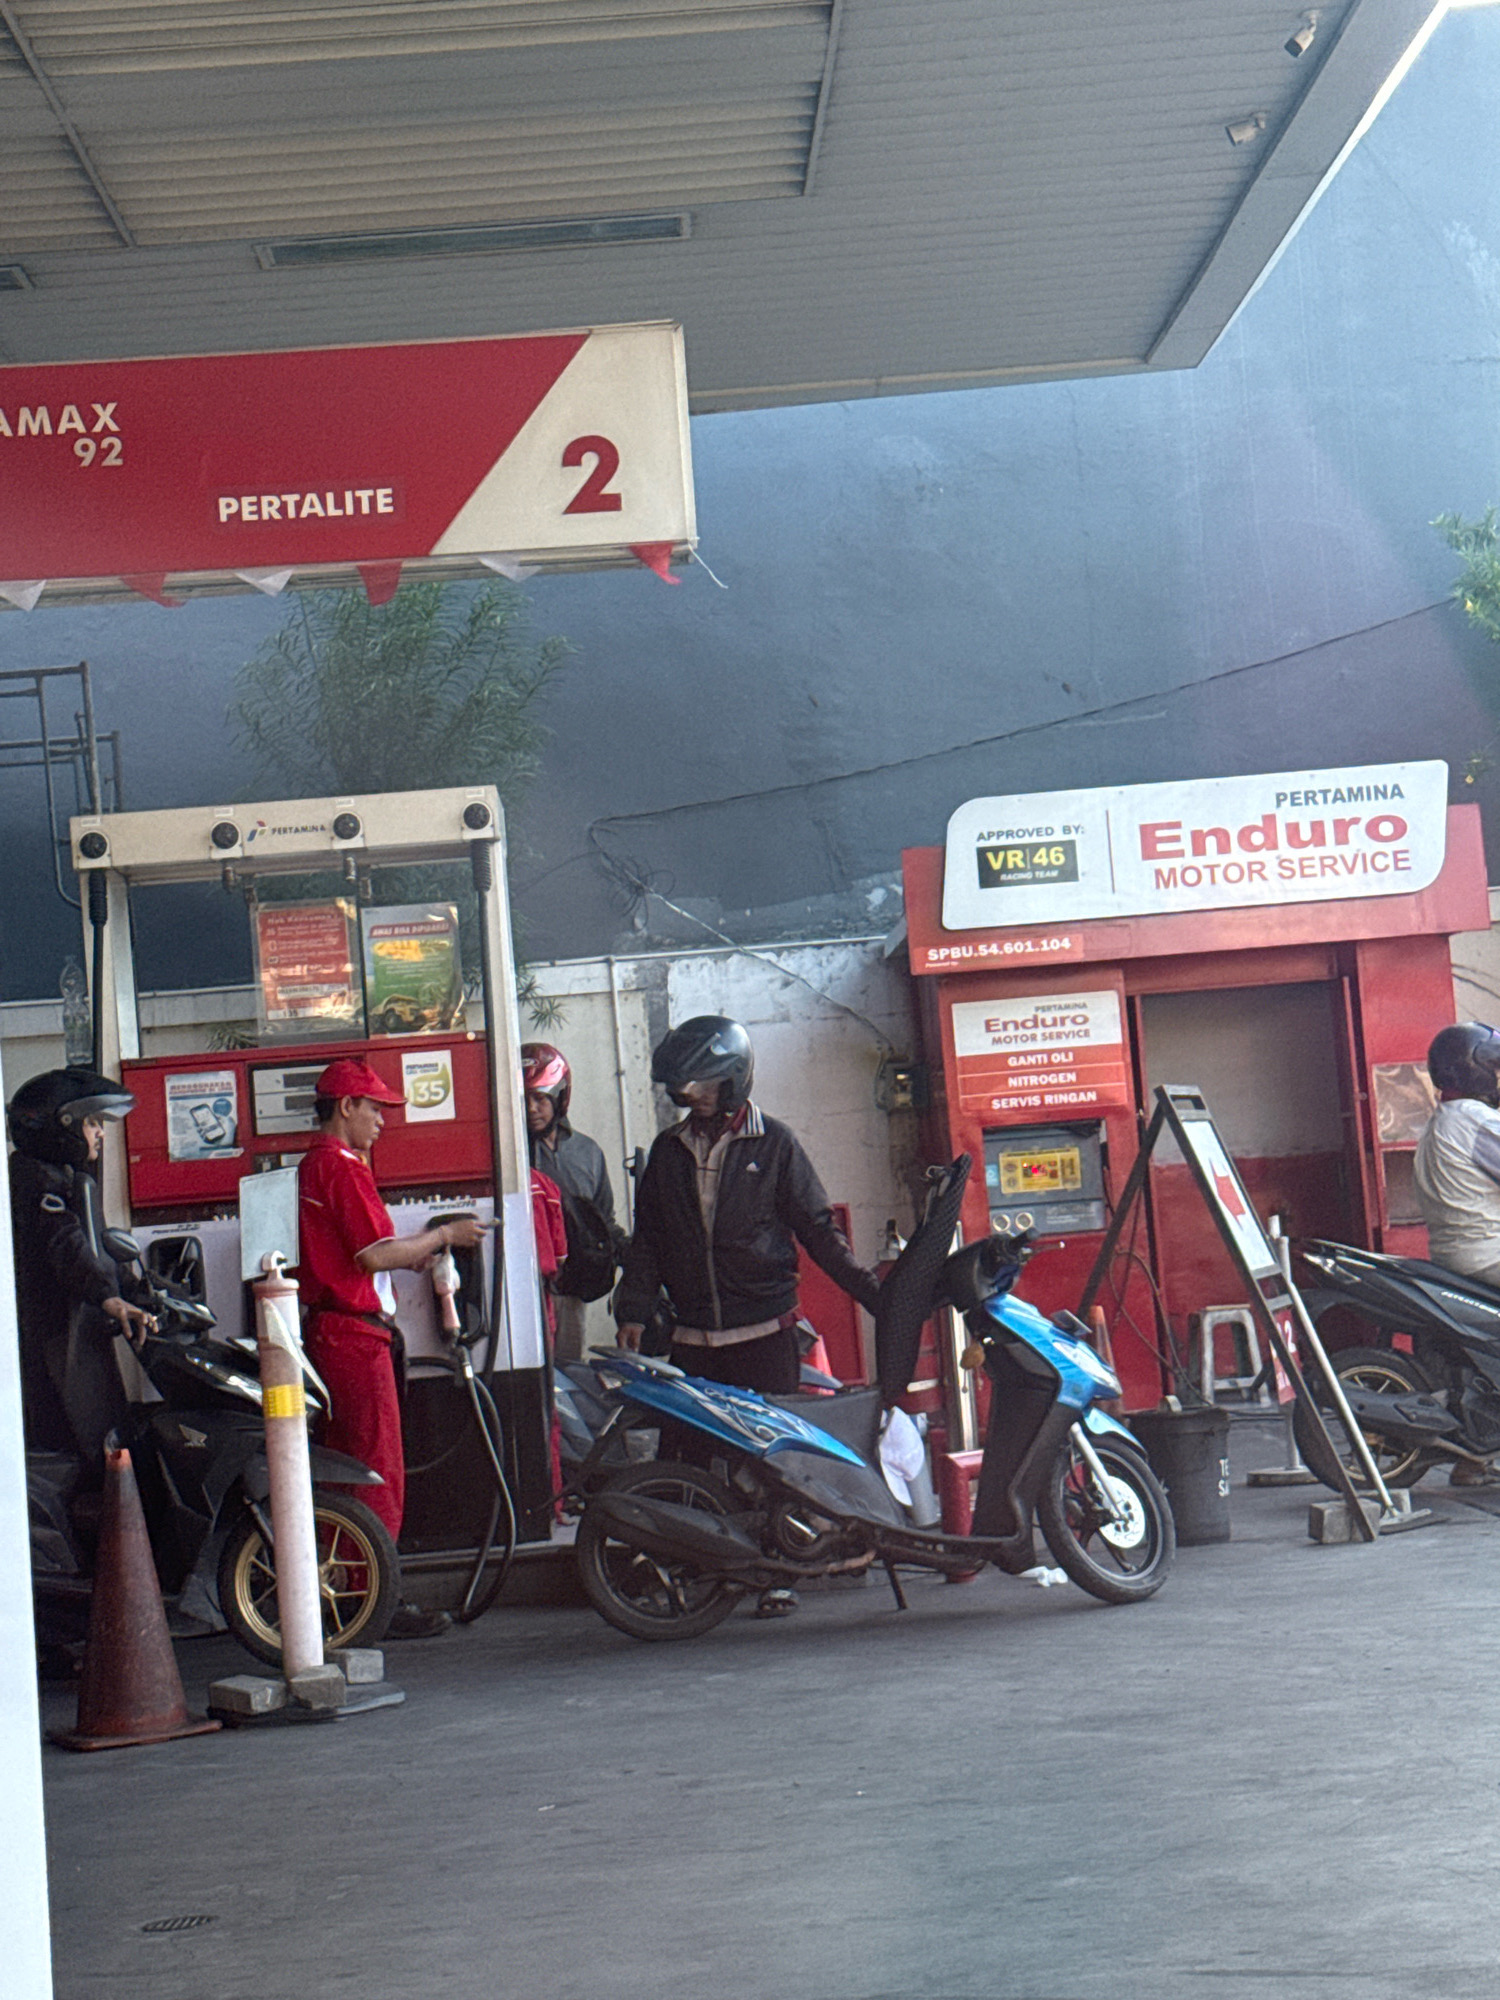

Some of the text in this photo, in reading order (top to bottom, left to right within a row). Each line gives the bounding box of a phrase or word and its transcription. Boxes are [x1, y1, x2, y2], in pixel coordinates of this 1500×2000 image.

[73, 436, 124, 468] 92
[561, 434, 623, 515] 2
[218, 487, 395, 523] PERTALITE
[1275, 783, 1405, 809] PERTAMINA
[271, 824, 326, 836] PERTAMINA
[976, 824, 1085, 842] APPROVED BY:
[1139, 813, 1408, 862] Enduro
[1000, 870, 1059, 881] RACING TEAM
[1154, 849, 1412, 890] MOTOR SERVICE
[927, 937, 1072, 961] SPBU.54.601.104
[1034, 1002, 1088, 1013] PERTAMINA
[984, 1013, 1090, 1034] Enduro
[991, 1028, 1091, 1046] MOTOR SERVICE
[1007, 1051, 1074, 1067] GANTI OLI
[1008, 1072, 1077, 1087] NITROGEN
[991, 1090, 1097, 1110] SERVIS RINGAN
